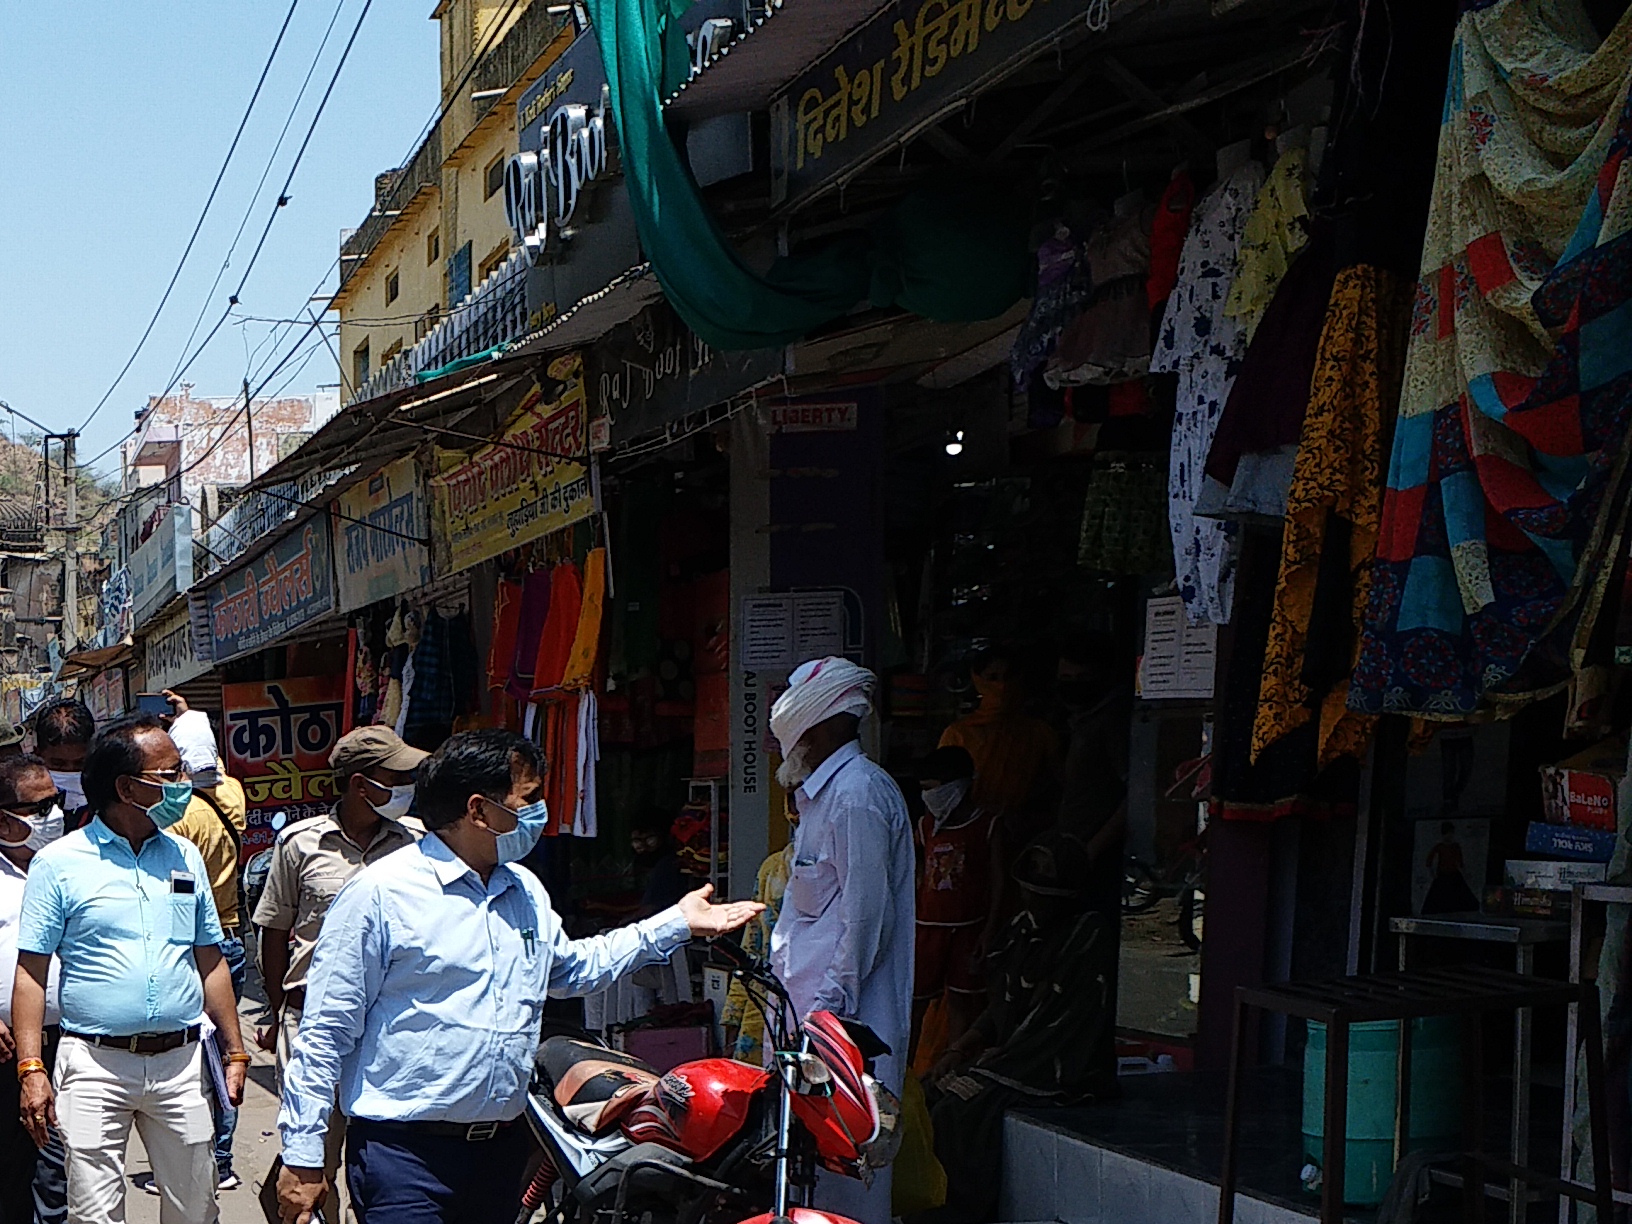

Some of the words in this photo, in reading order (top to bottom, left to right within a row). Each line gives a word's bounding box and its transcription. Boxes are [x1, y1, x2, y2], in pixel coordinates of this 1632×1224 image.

[796, 57, 886, 170] दिनेश
[503, 126, 551, 268] Raj
[548, 82, 608, 228] Boot
[549, 481, 563, 513] की
[563, 477, 588, 515] दुकान
[212, 567, 260, 642] कोठारी
[258, 523, 313, 620] ज्वैलर्स
[744, 692, 757, 736] BOOT
[744, 740, 757, 794] HOUSE
